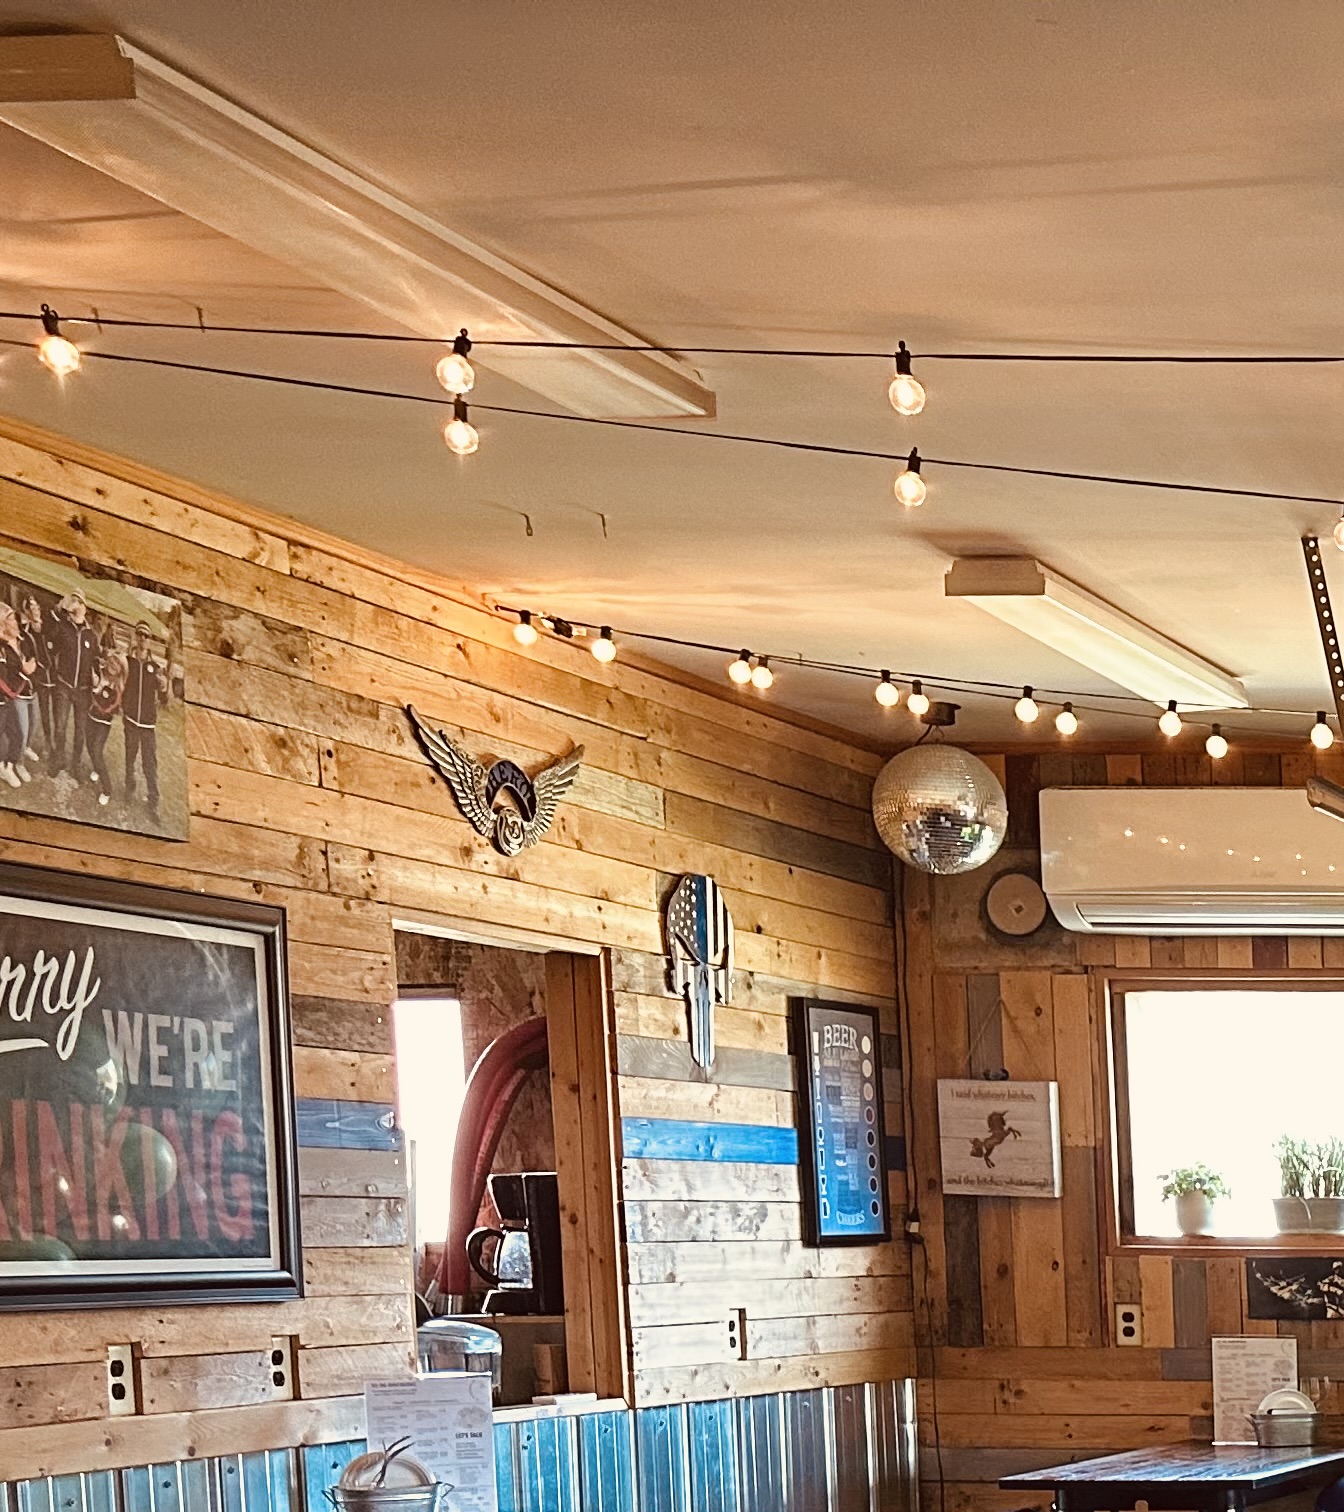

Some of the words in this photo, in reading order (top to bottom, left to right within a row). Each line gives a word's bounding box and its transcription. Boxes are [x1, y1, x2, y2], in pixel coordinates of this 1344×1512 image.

[102, 1009, 237, 1092] WE'RE
[823, 1024, 859, 1053] BEER
[0, 1099, 255, 1241] INKING
